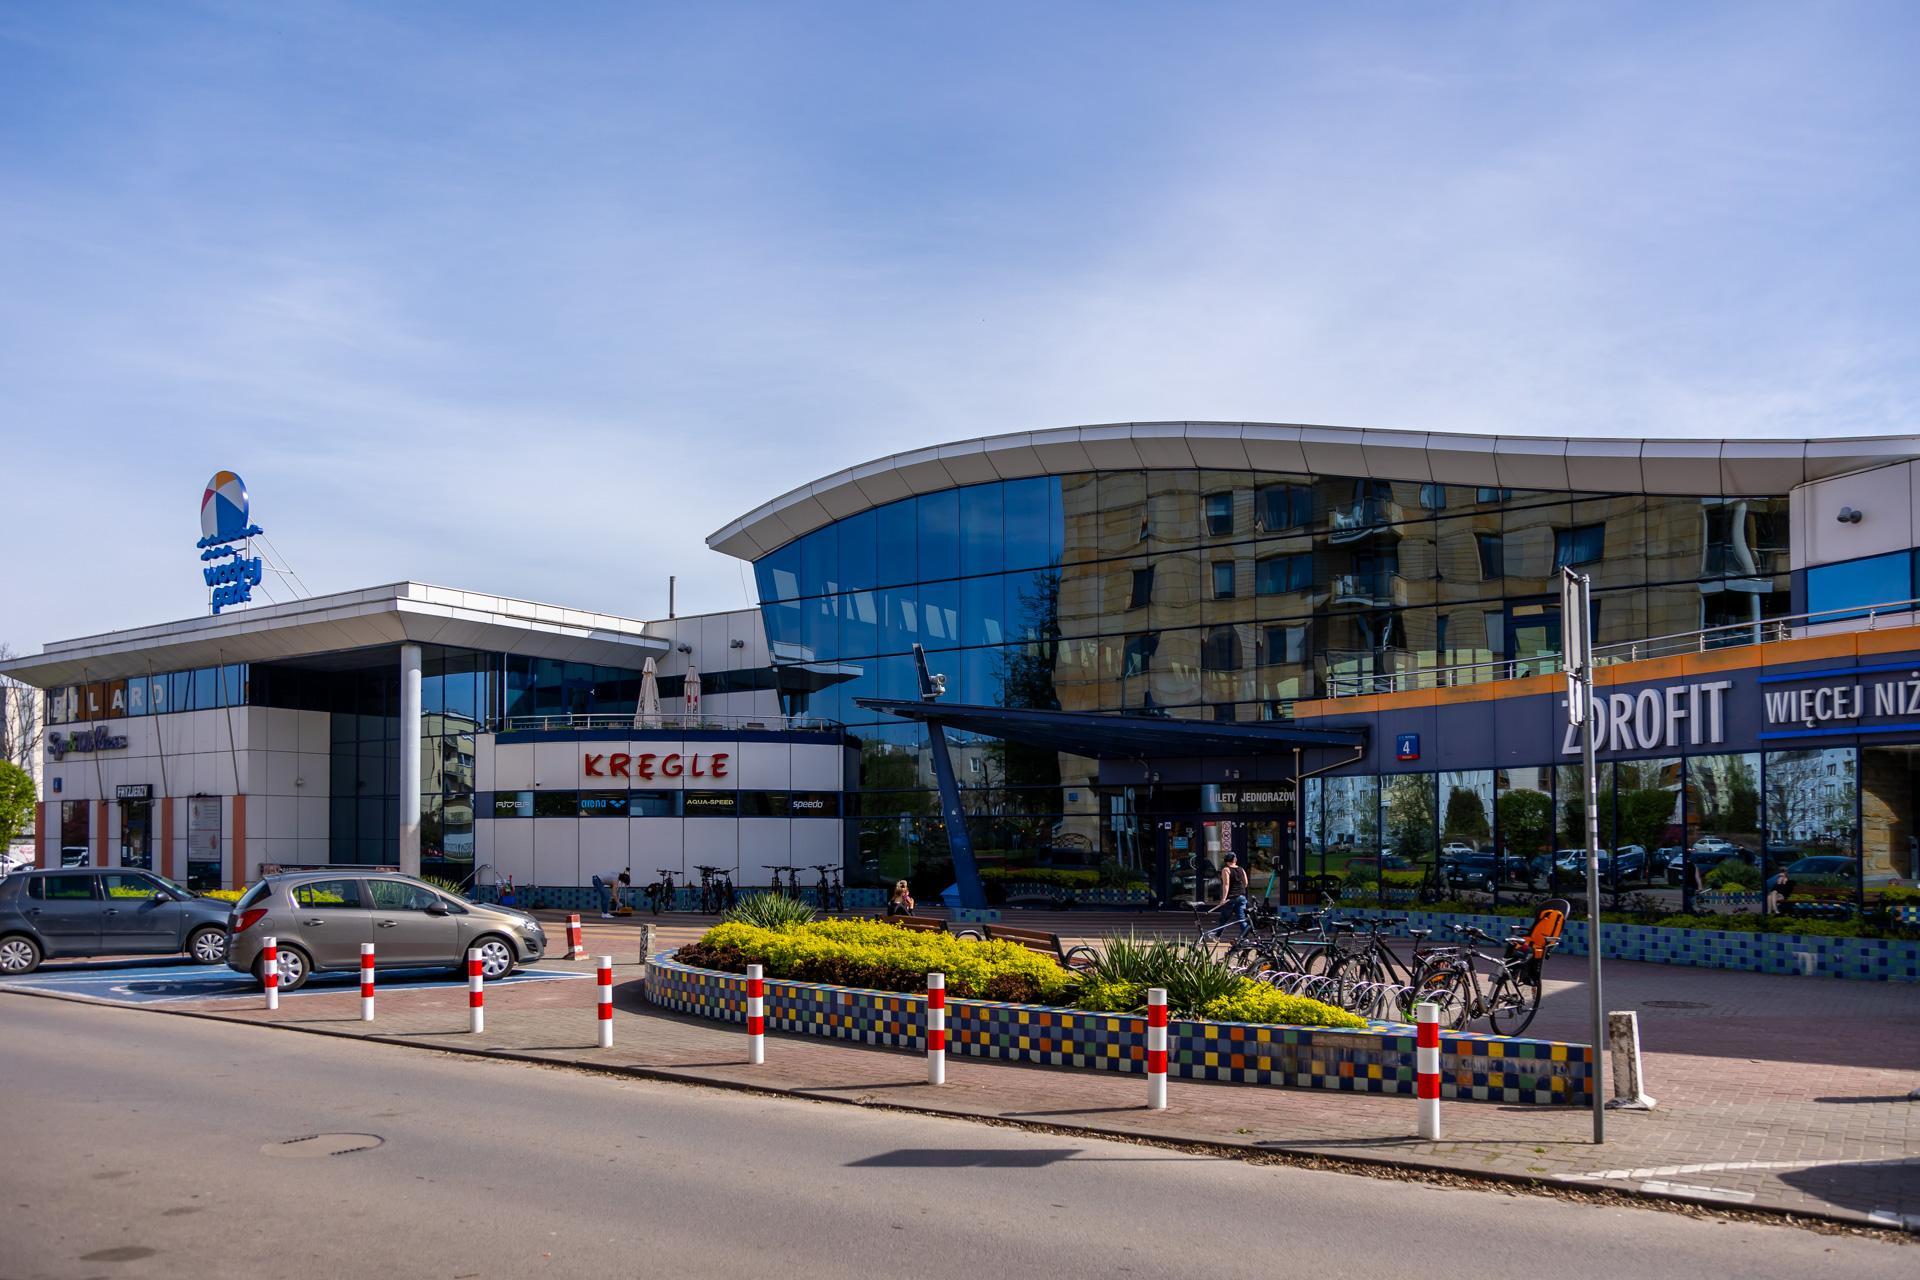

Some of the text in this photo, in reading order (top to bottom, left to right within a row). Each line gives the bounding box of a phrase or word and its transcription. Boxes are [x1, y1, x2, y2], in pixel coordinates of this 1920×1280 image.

[1765, 670, 1920, 728] WIĘCEJ NIŻ
[1402, 740, 1410, 754] 4
[584, 752, 730, 780] KRĘGLE
[793, 800, 823, 809] speedo
